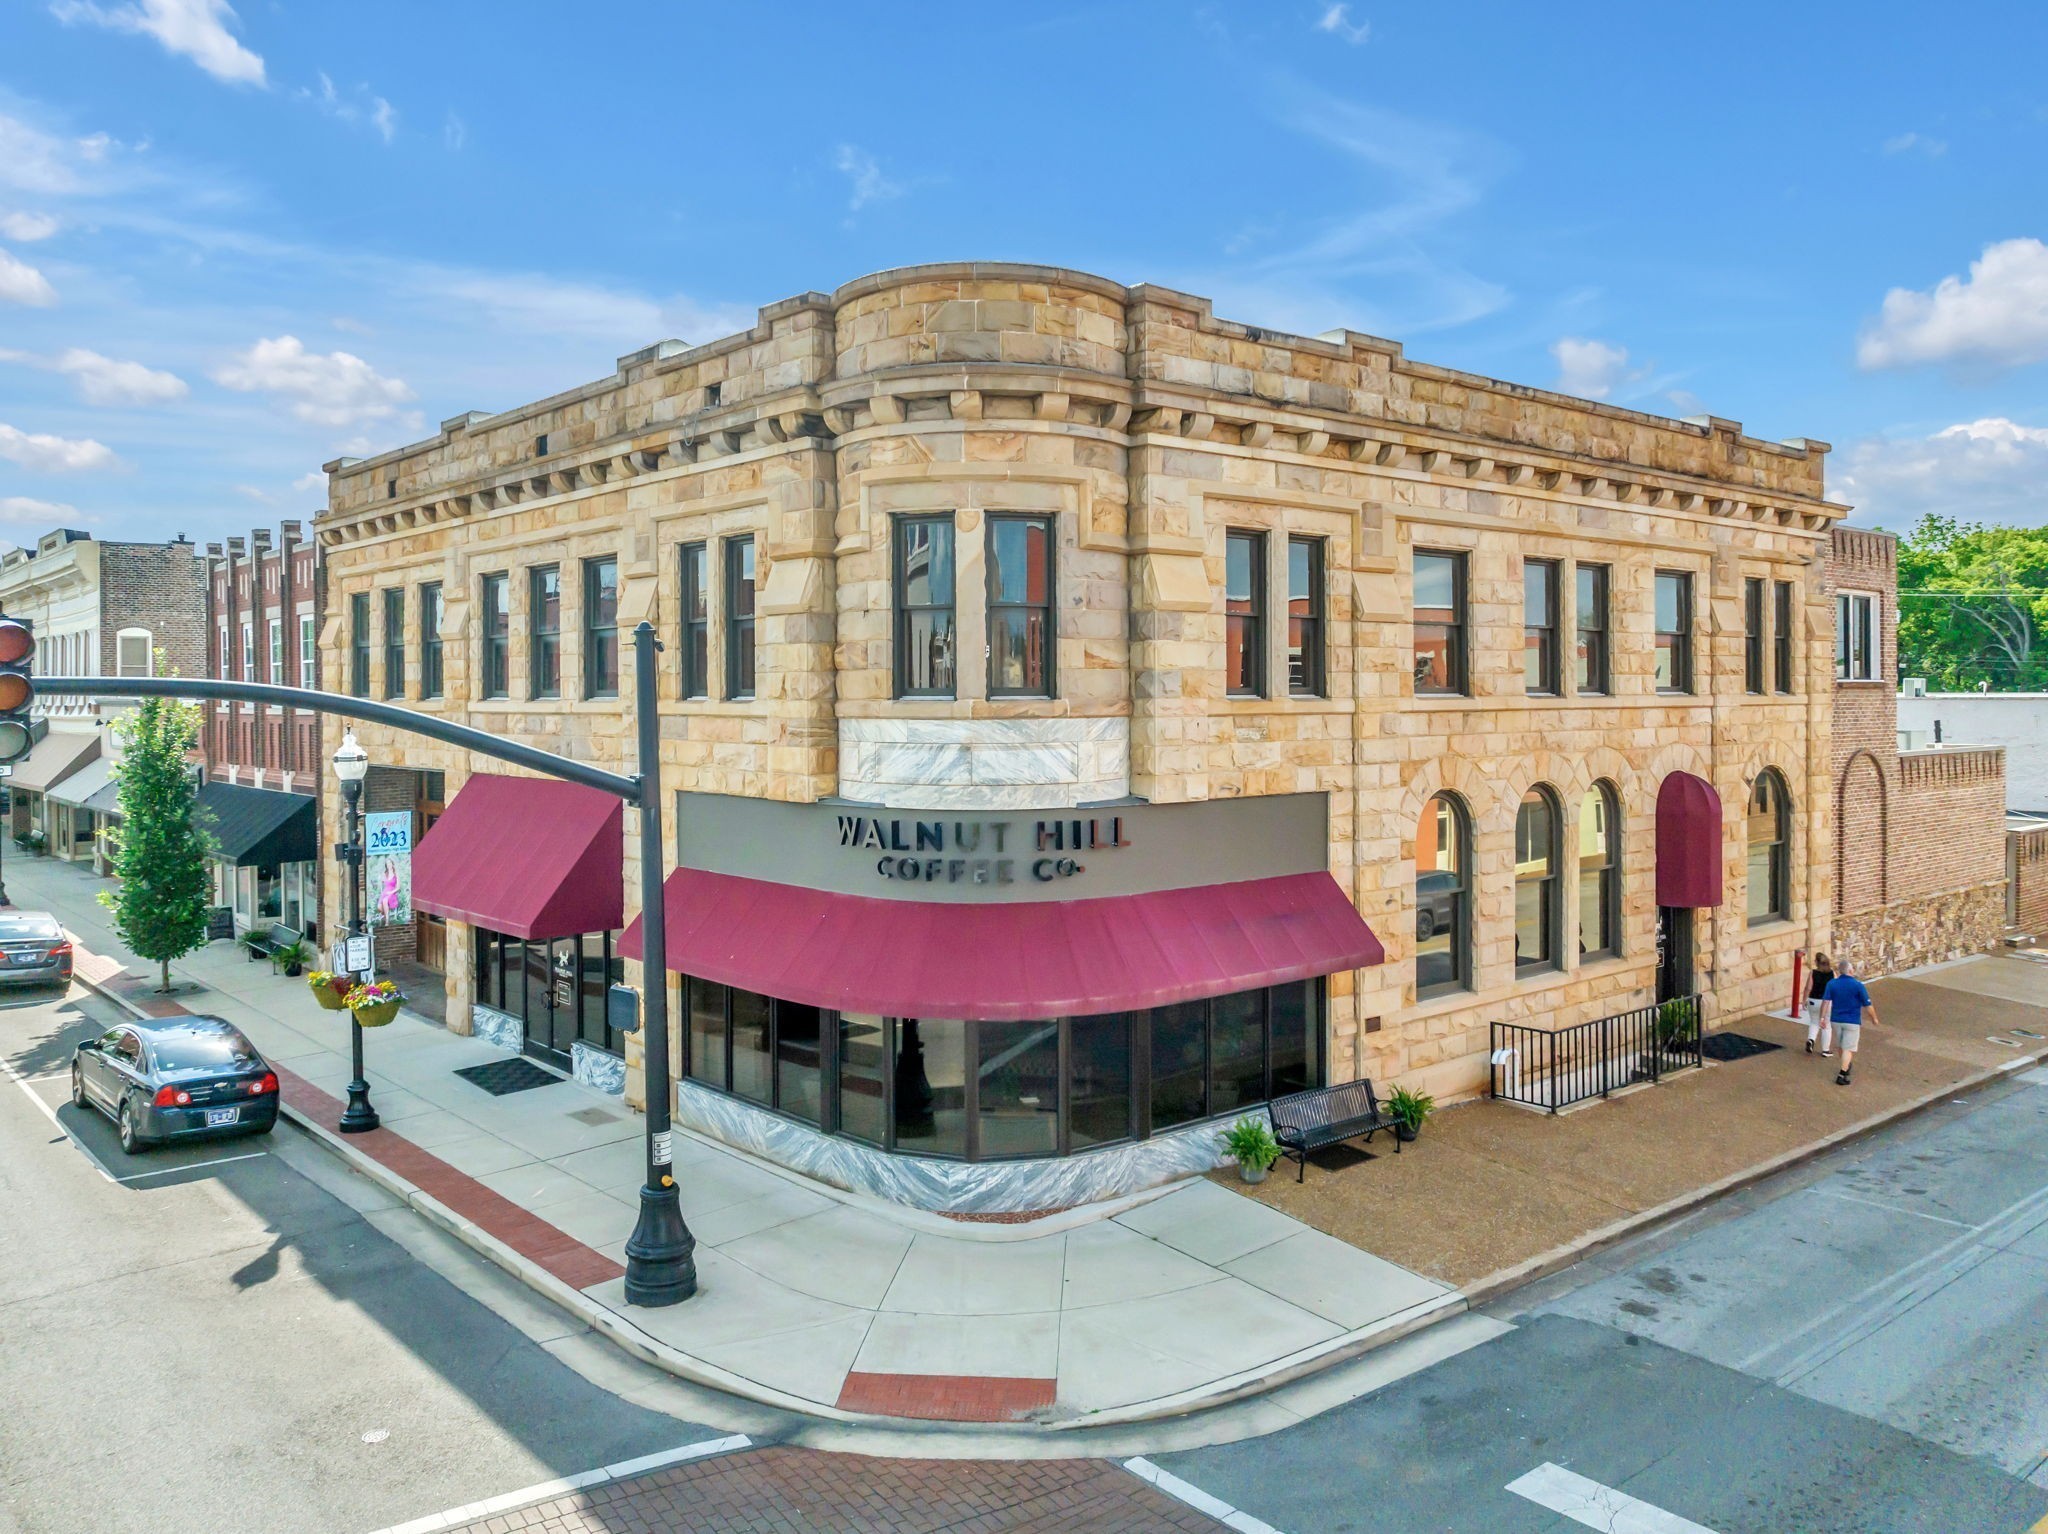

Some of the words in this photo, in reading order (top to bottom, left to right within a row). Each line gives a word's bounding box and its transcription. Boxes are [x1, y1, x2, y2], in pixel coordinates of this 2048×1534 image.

[371, 830, 407, 848] 2023
[837, 816, 1012, 853] WALNUT
[1037, 816, 1132, 852] HILL
[877, 855, 1014, 885] COFFEE
